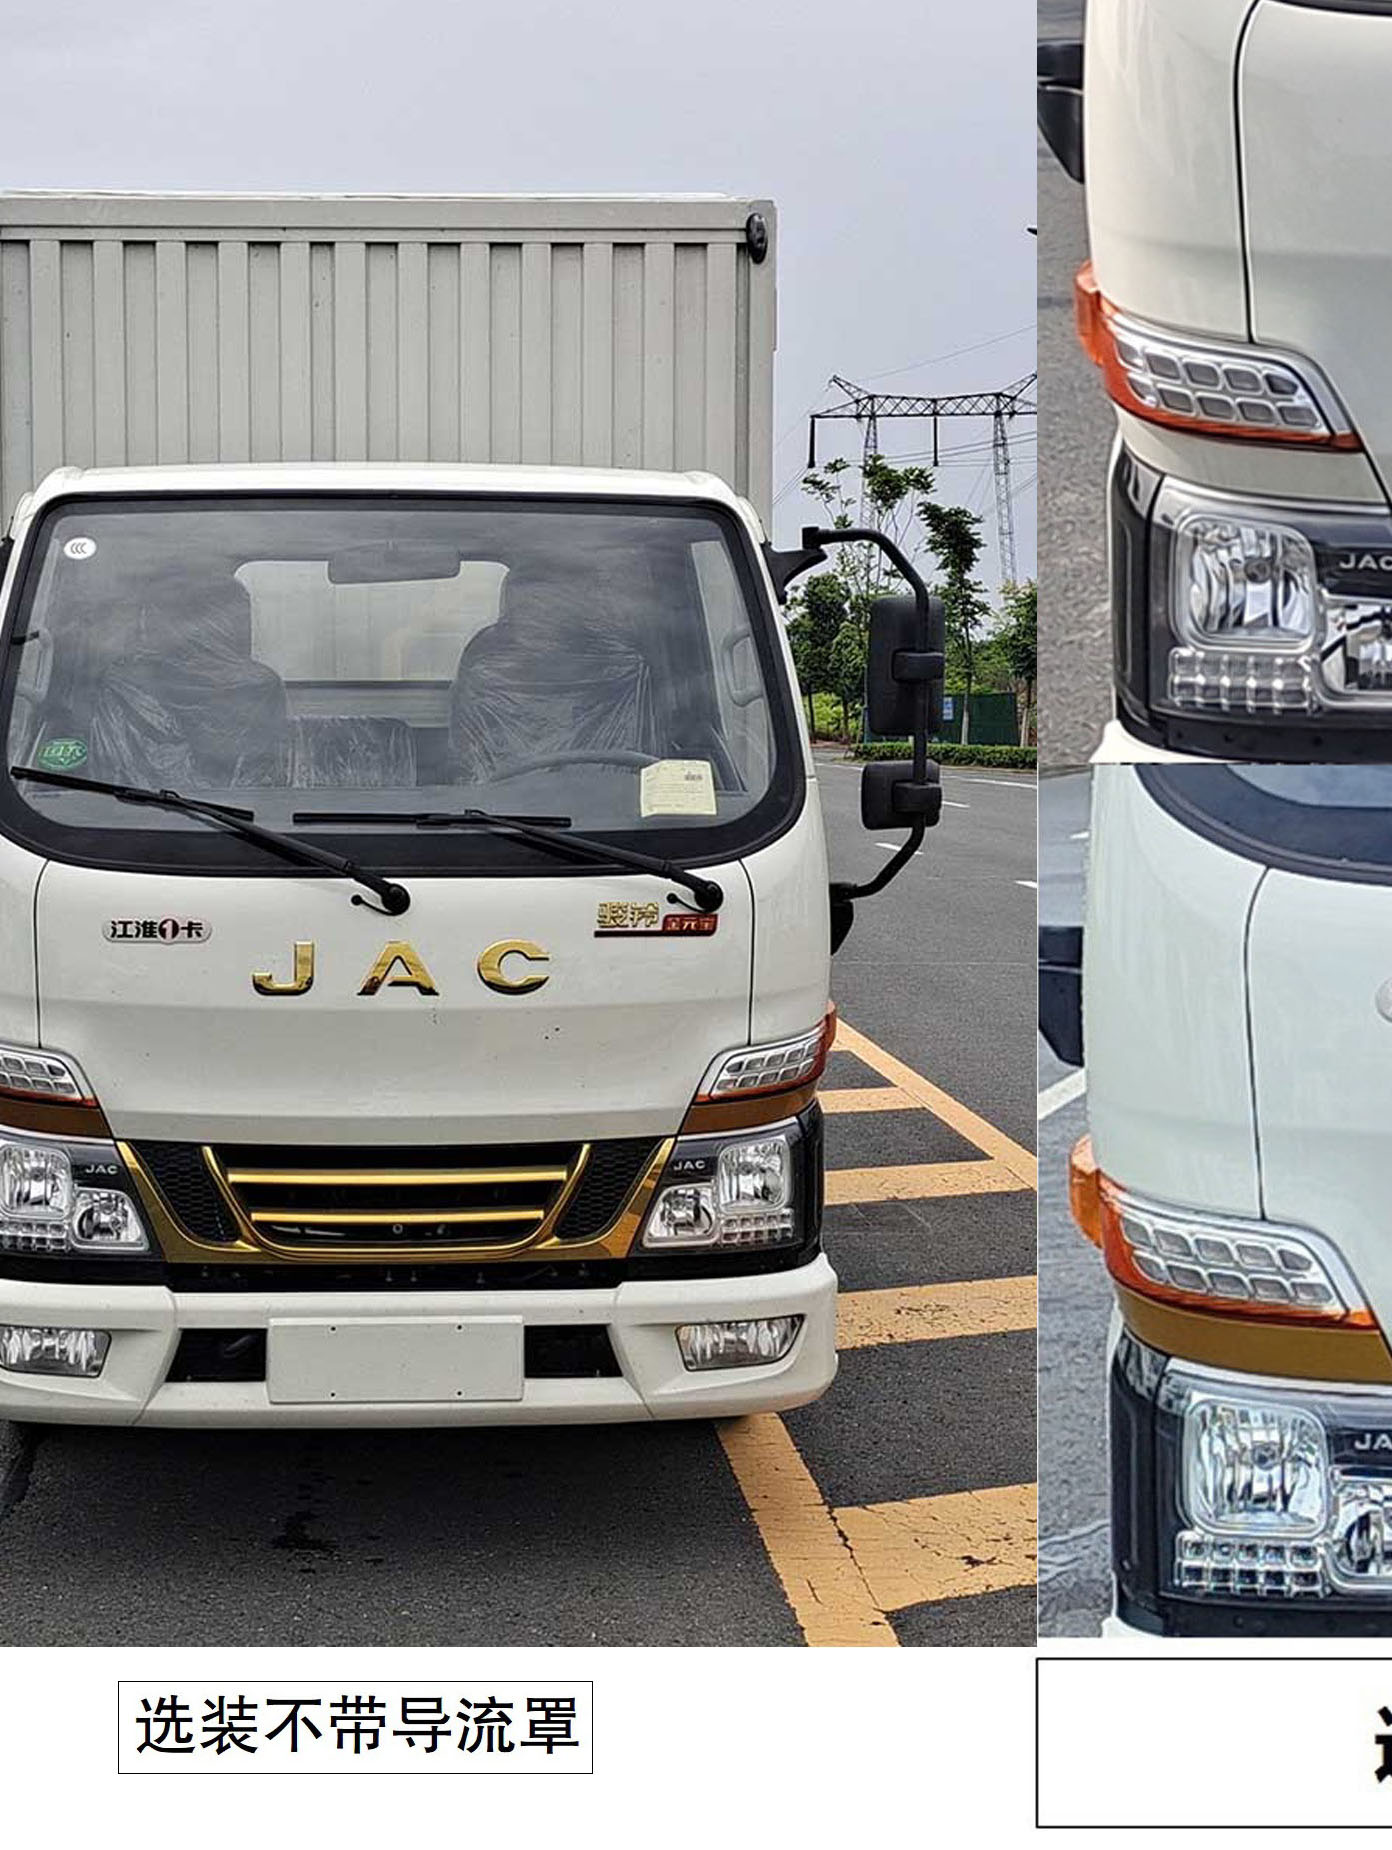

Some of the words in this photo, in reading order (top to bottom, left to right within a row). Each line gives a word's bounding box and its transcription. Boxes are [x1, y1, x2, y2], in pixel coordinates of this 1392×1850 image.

[252, 939, 550, 996] JAC
[85, 1163, 119, 1175] JAC
[672, 1160, 707, 1172] JAC
